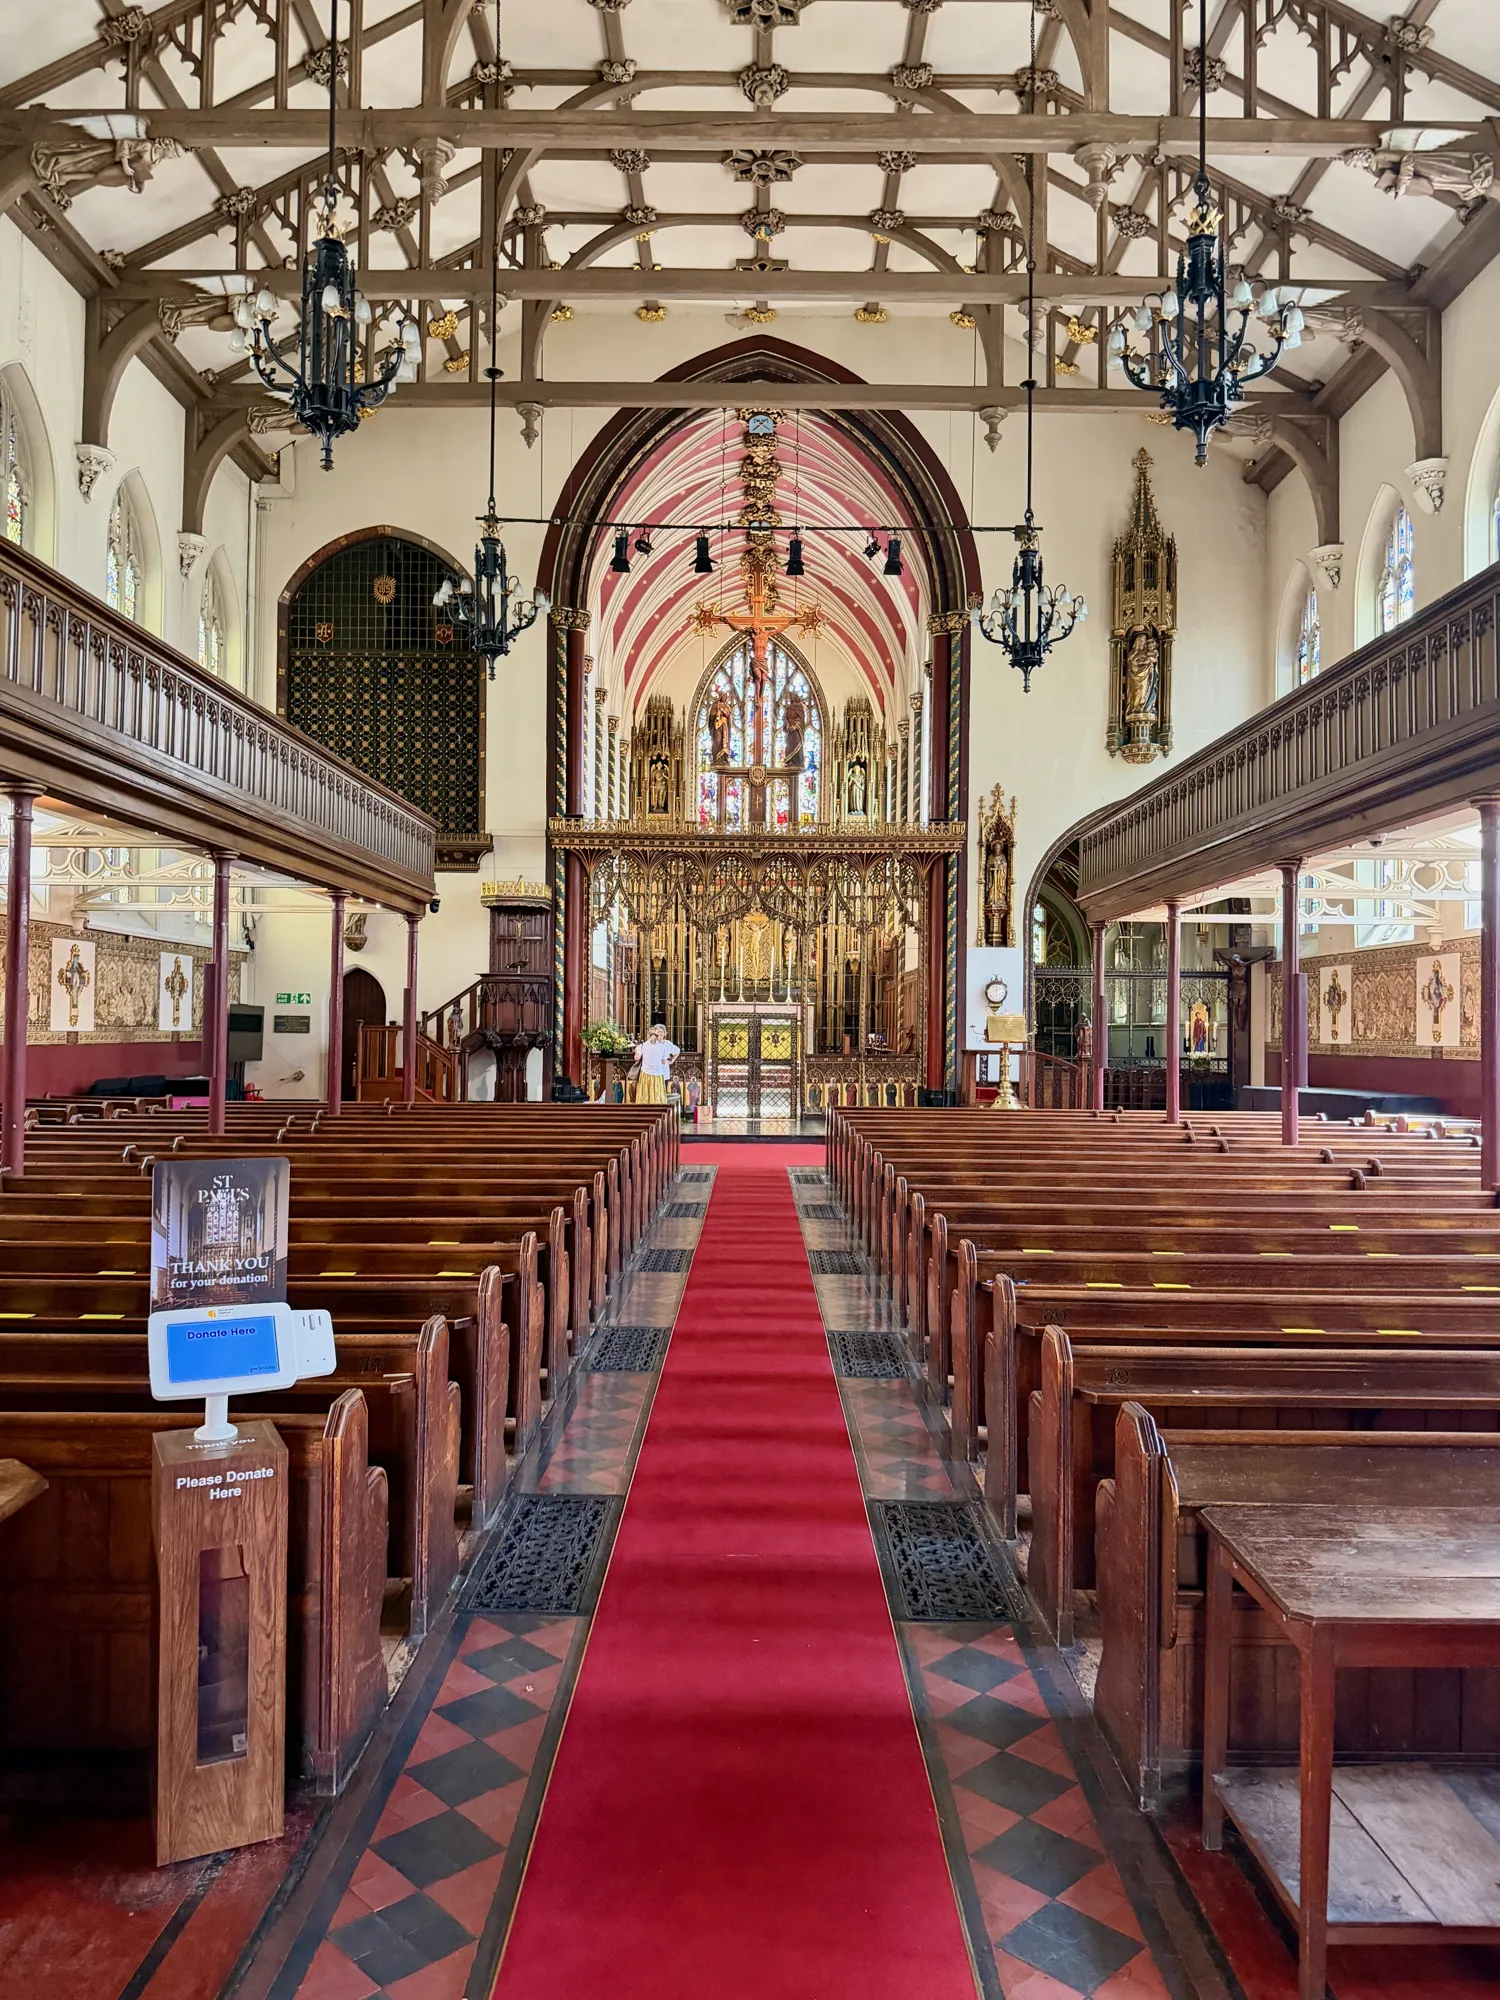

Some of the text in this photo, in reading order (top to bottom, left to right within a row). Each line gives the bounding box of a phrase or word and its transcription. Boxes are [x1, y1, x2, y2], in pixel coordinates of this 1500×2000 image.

[213, 1175, 233, 1189] ST
[171, 1256, 270, 1275] THANK YOU
[170, 1273, 269, 1290] for your donation
[187, 1326, 256, 1340] Donate Here
[1105, 1367, 1130, 1385] 79
[185, 1437, 256, 1450] Thank you
[176, 1466, 274, 1490] Please Donate
[209, 1486, 242, 1500] Here
